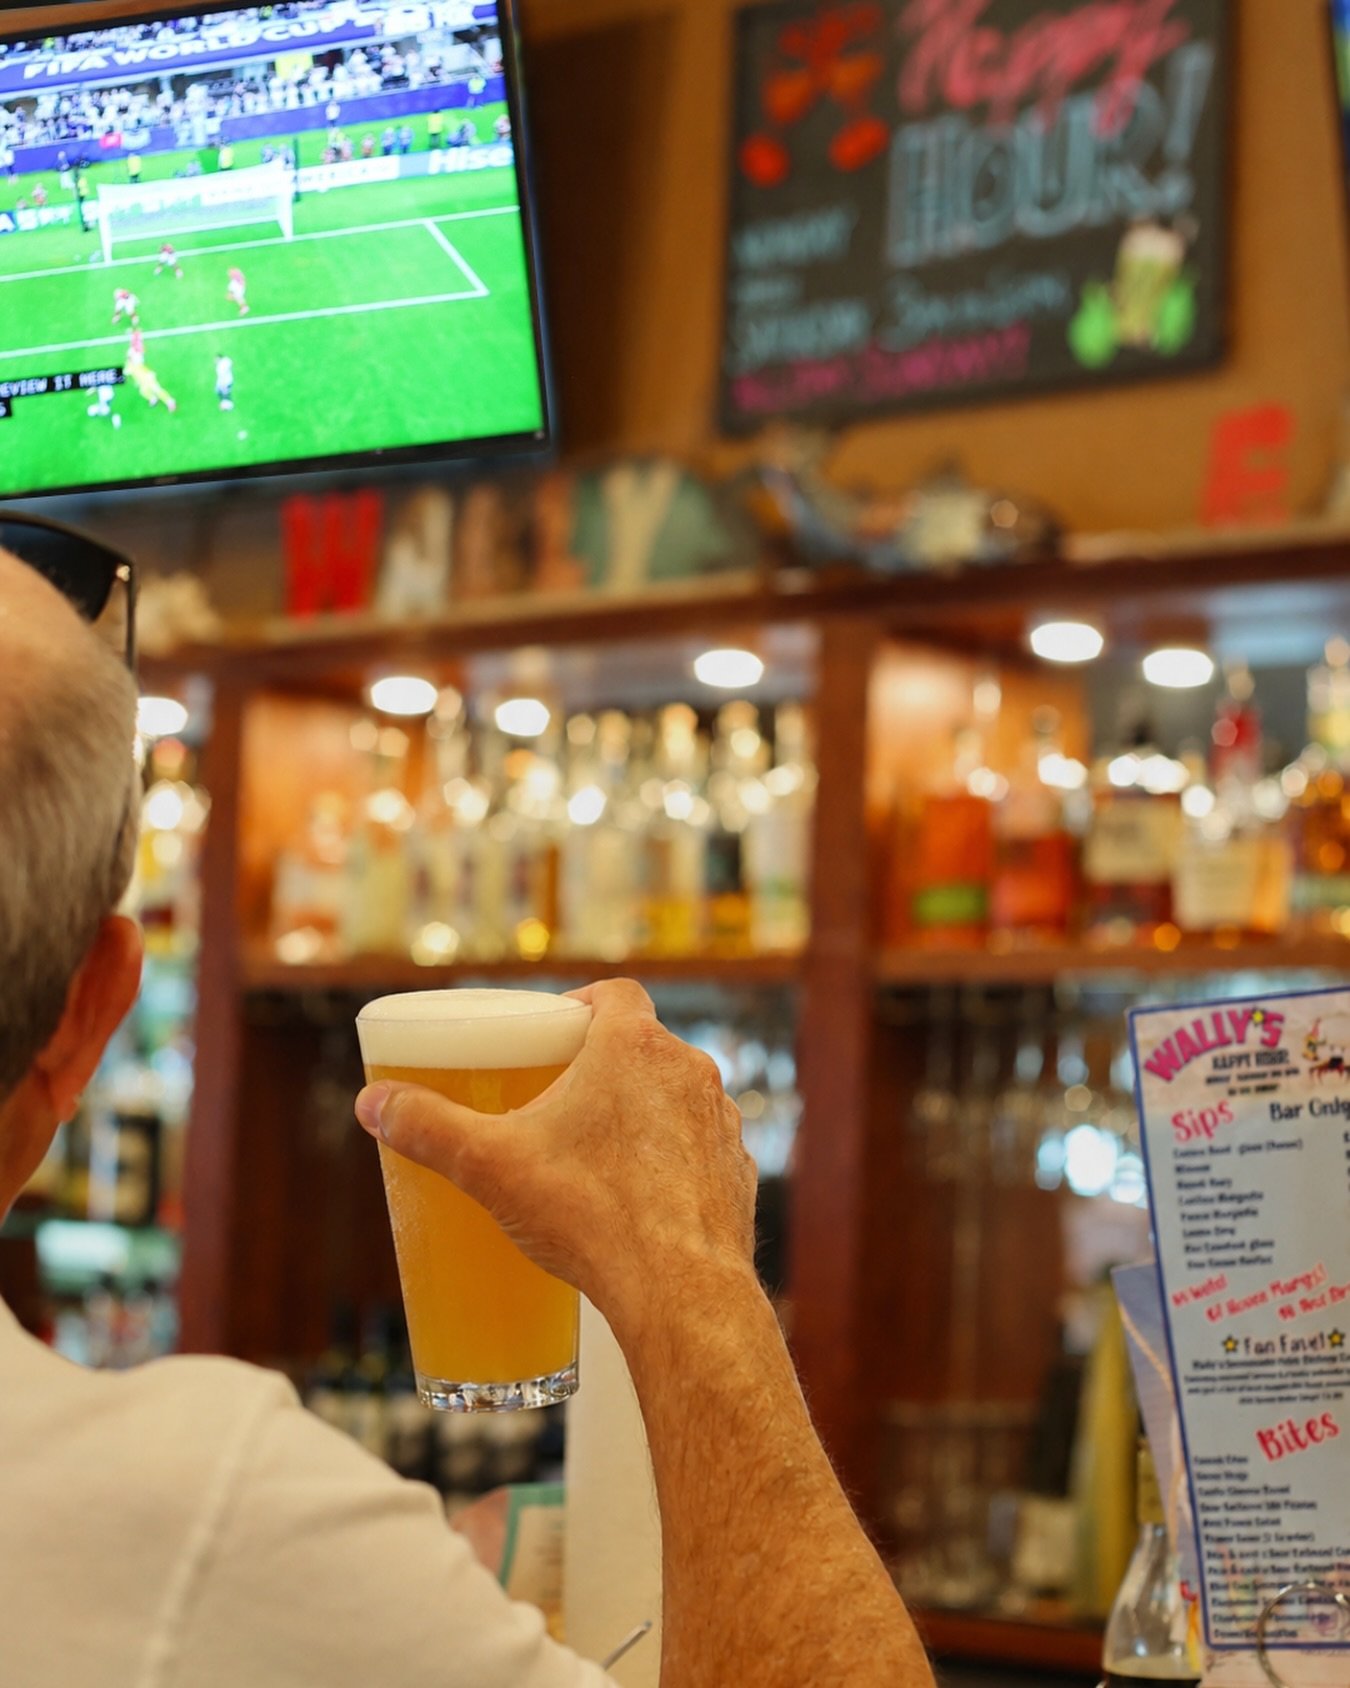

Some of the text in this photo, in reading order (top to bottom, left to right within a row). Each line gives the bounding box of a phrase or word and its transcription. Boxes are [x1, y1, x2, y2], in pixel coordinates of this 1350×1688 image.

[24, 17, 345, 79] FIFA WORLD CUP
[54, 374, 72, 391] IT
[1144, 1008, 1285, 1083] WALLY'S
[1171, 1100, 1234, 1142] Sips
[1270, 1102, 1302, 1122] Bar
[1244, 1337, 1275, 1355] Fan
[1256, 1412, 1340, 1461] Bites
